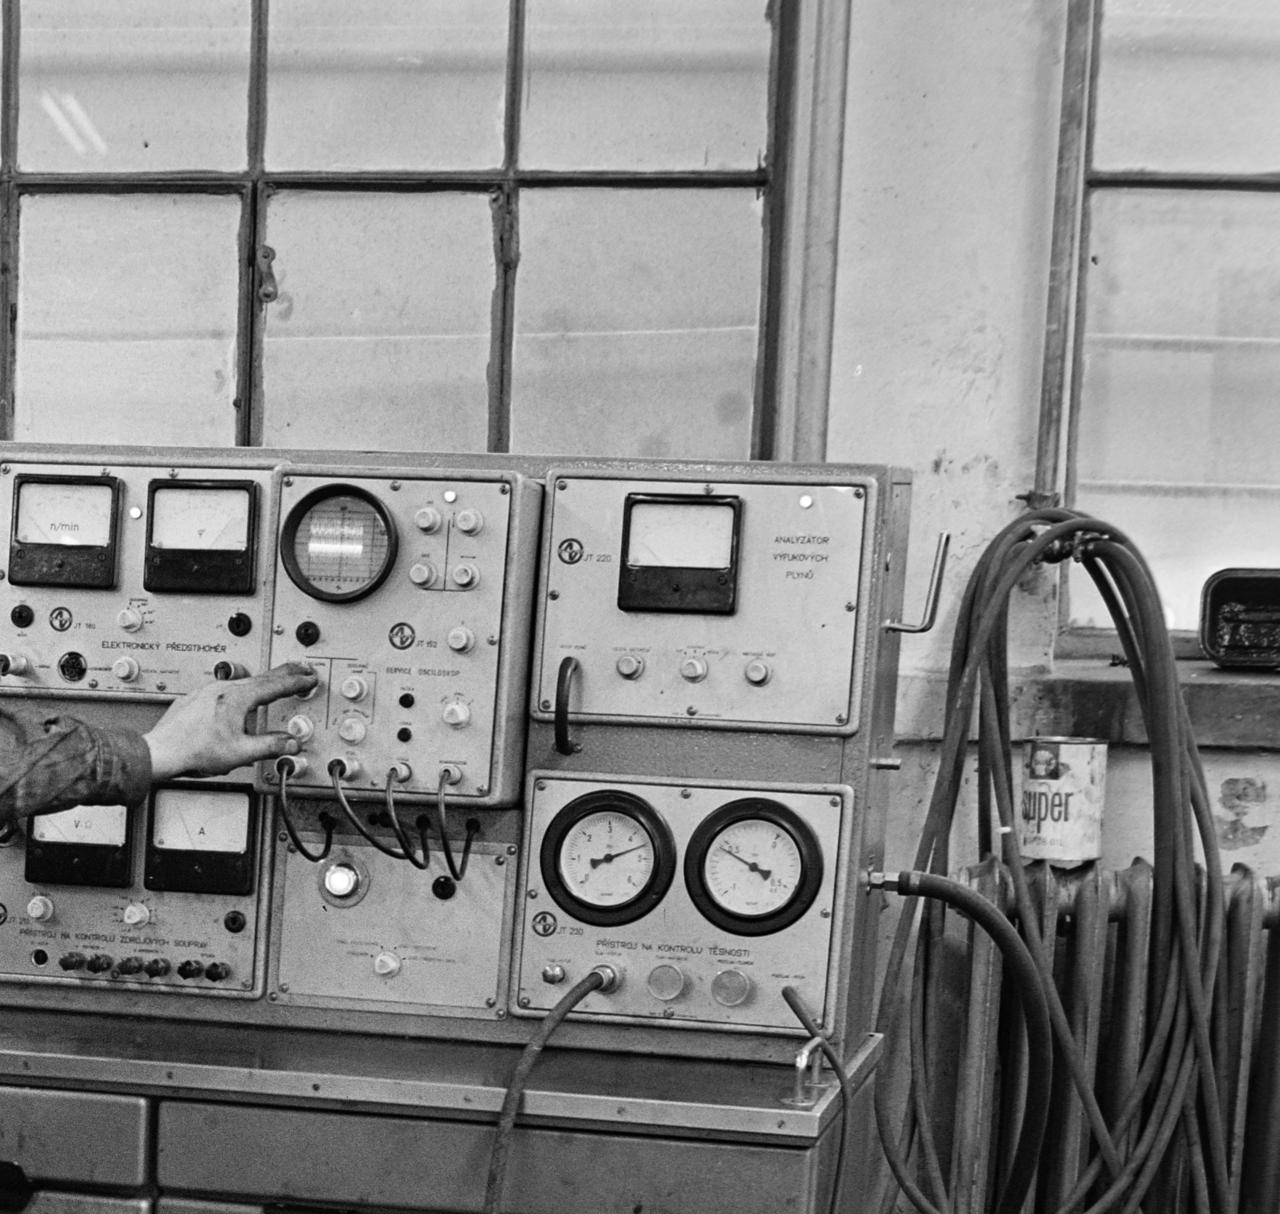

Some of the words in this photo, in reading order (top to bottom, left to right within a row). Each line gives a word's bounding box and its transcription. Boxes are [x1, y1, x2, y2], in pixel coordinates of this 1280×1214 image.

[49, 520, 80, 533] n/min
[583, 552, 595, 562] JT
[197, 826, 207, 837] A
[641, 943, 653, 951] NA
[657, 943, 703, 955] KONTROLU
